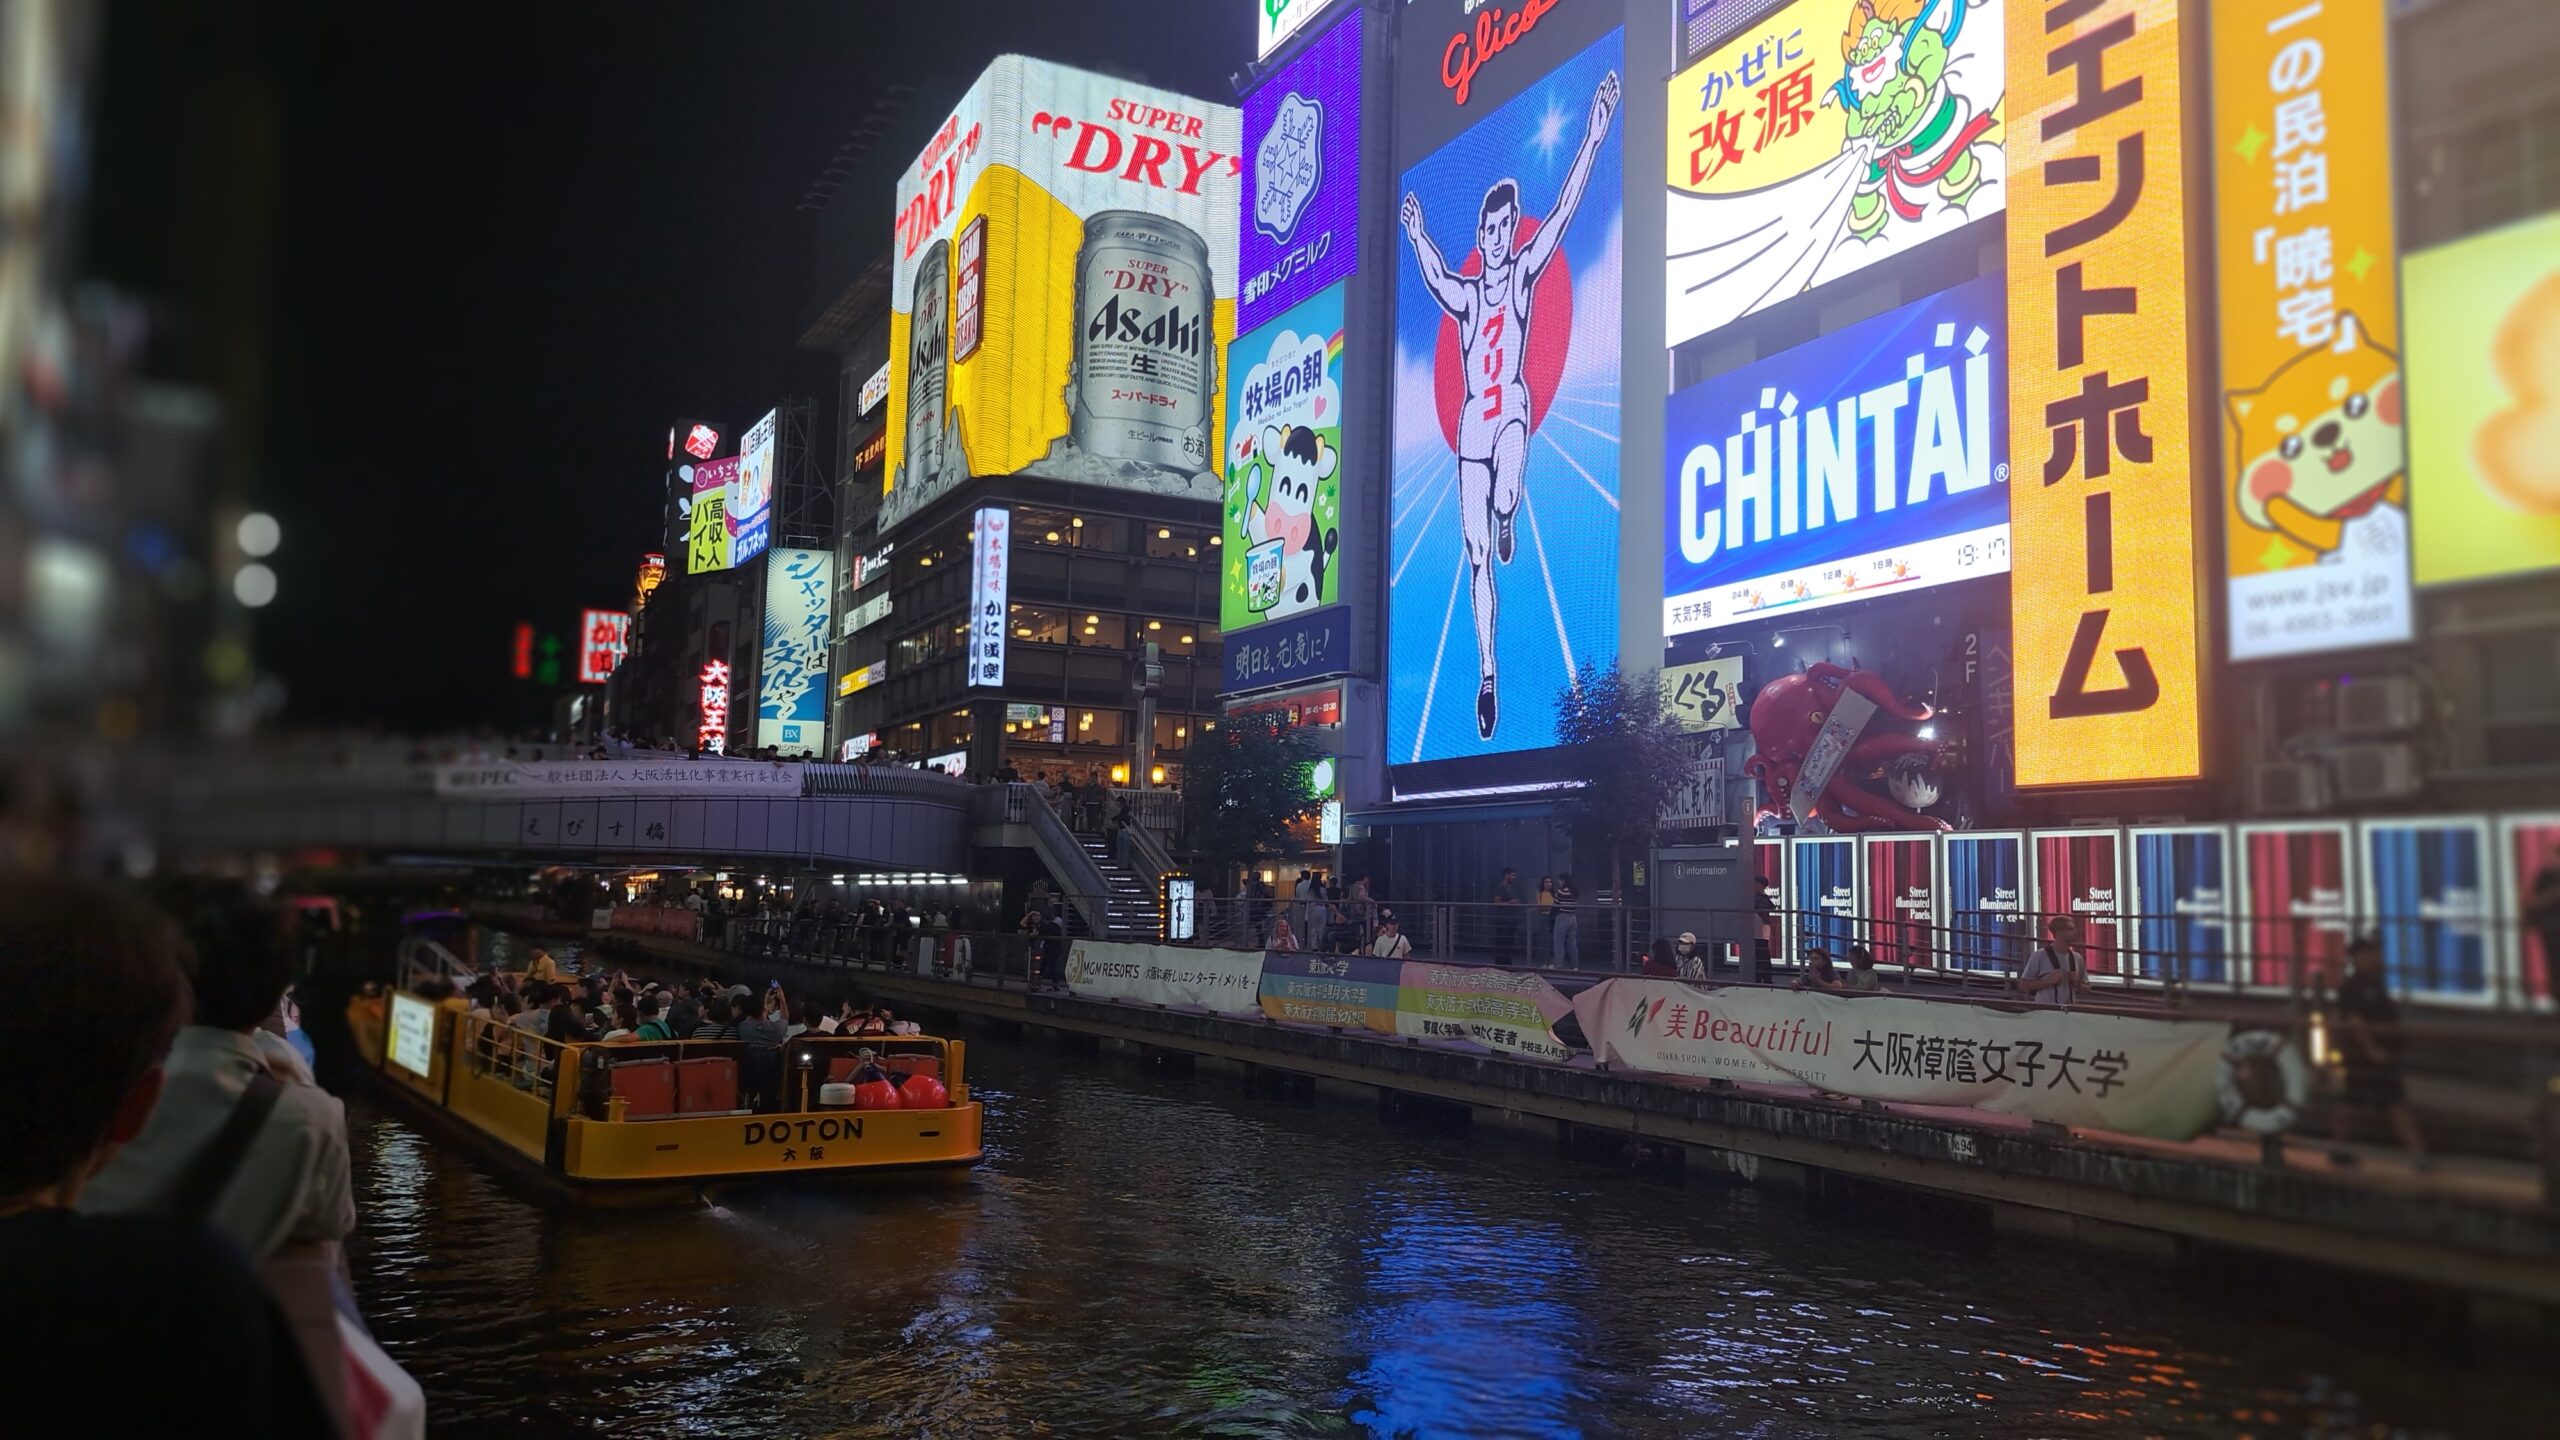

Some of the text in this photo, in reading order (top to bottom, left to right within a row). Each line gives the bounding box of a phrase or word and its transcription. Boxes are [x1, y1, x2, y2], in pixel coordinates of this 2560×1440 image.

[1442, 0, 1558, 105] Glico
[1701, 28, 1803, 112] かぜに
[1107, 98, 1204, 138] SUPER
[1689, 57, 1816, 187] 改源
[1128, 259, 1169, 275] SUPER
[1243, 231, 1331, 305] 雪印メグミルク
[1089, 294, 1199, 359] Asahi
[1130, 353, 1159, 377] 生
[1482, 304, 1505, 422] グリコ
[1246, 348, 1322, 421] 牧場の朝
[1111, 388, 1177, 409] スーパードライ
[1680, 322, 1991, 564] CHINTAI
[693, 500, 711, 571] バイト
[706, 498, 725, 568] 高収入
[1671, 600, 1713, 625] 天気予報
[784, 728, 799, 738] BX
[776, 743, 815, 752] 化シャッター
[1686, 866, 1728, 876] information
[1833, 885, 1851, 897] Street
[1909, 886, 1929, 898] Street
[1994, 887, 2016, 900] Street
[2089, 887, 2113, 900] Street
[1681, 1054, 1707, 1065] SHOIN
[1852, 1029, 2129, 1098] 大阪樟蔭女子大学
[744, 1116, 864, 1146] DOTON
[783, 1146, 825, 1162] 大阪
